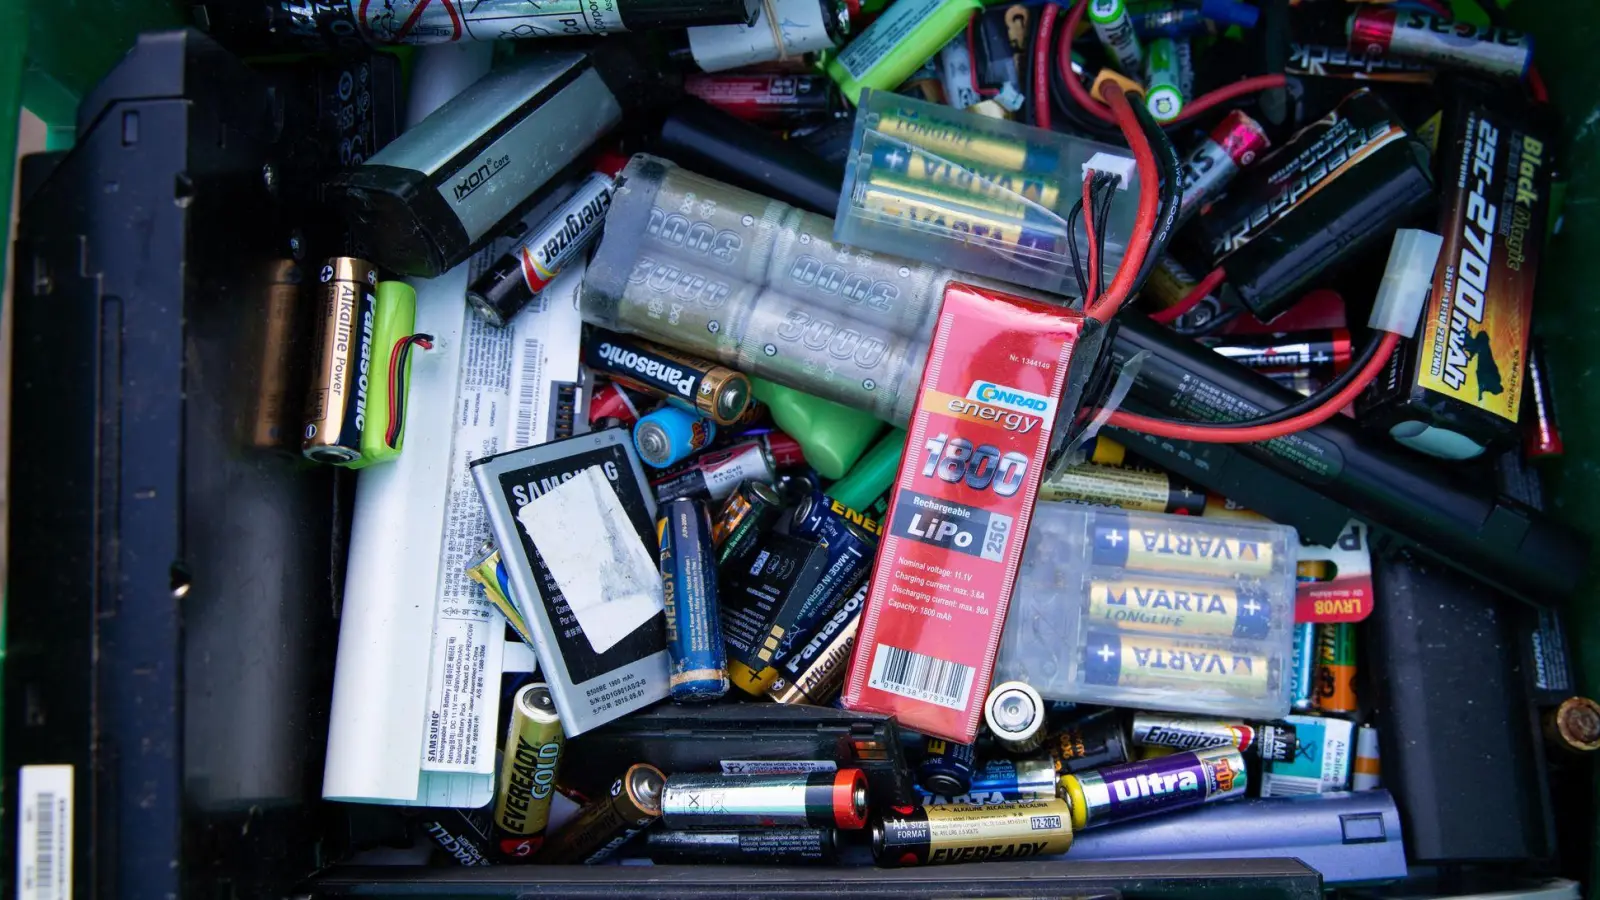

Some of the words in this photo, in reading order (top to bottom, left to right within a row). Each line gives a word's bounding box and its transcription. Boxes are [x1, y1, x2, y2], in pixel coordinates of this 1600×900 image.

[563, 19, 580, 34] Cd
[593, 0, 602, 30] Corpor
[1406, 10, 1523, 47] arcas
[493, 154, 510, 171] Core
[1516, 135, 1544, 208] Black
[543, 190, 613, 264] Energizer
[788, 253, 900, 313] 3000
[336, 284, 355, 357] Alkaline
[776, 309, 890, 370] 3000
[332, 355, 348, 396] Power
[354, 292, 377, 432] Panasonic
[598, 341, 697, 397] Panasonic
[1009, 353, 1020, 364] Nr.
[1021, 357, 1051, 370] 1344149
[975, 382, 1048, 412] CONRAD
[948, 398, 1040, 434] energy
[921, 432, 1029, 498] 1800
[512, 460, 619, 507] SAMSG
[830, 499, 882, 537] ENE
[913, 495, 971, 519] Rechargeable
[907, 513, 973, 548] LiPo
[986, 520, 1008, 554] 25C
[1142, 530, 1233, 560] VARTA
[827, 551, 849, 577] MADE
[898, 556, 927, 572] Nominal
[926, 564, 953, 579] voltage:
[954, 570, 973, 582] 11.1V
[821, 573, 832, 585] IN
[895, 570, 925, 587] Charging
[925, 578, 952, 592] current:
[952, 587, 969, 597] max.
[661, 569, 677, 641] ENERGY
[888, 598, 919, 614] Capacity:
[919, 606, 936, 617] 1800
[936, 611, 953, 621] mAh
[891, 584, 931, 603] Discharging
[931, 595, 958, 608] current:
[958, 603, 975, 613] max.
[1132, 587, 1228, 615] VARTA
[1314, 598, 1362, 616] LRV08
[786, 580, 869, 674] Panason
[804, 635, 854, 691] Alkaline
[1132, 647, 1226, 675] VARTA
[460, 671, 469, 693] Product
[621, 672, 634, 682] mAh
[442, 688, 451, 708] Battery
[441, 708, 449, 724] Li-ion
[450, 719, 456, 729] DC
[457, 718, 466, 737] Battery
[426, 712, 440, 761] SAMSUNG
[437, 725, 448, 762] Rechargeable
[455, 738, 463, 764] Standard
[1143, 725, 1234, 751] Energizer
[531, 742, 560, 800] GOLD
[1332, 740, 1344, 783] Alkaline
[503, 735, 532, 833] EVEREADY
[986, 803, 1016, 811] ALCALINE
[892, 818, 908, 830] AA
[910, 819, 927, 829] SIZE
[897, 829, 927, 839] FORMAT
[1031, 816, 1061, 830] 12-2024
[427, 820, 476, 867] RACELL
[456, 834, 480, 861] POWER
[932, 841, 1049, 863] EVEREADY
